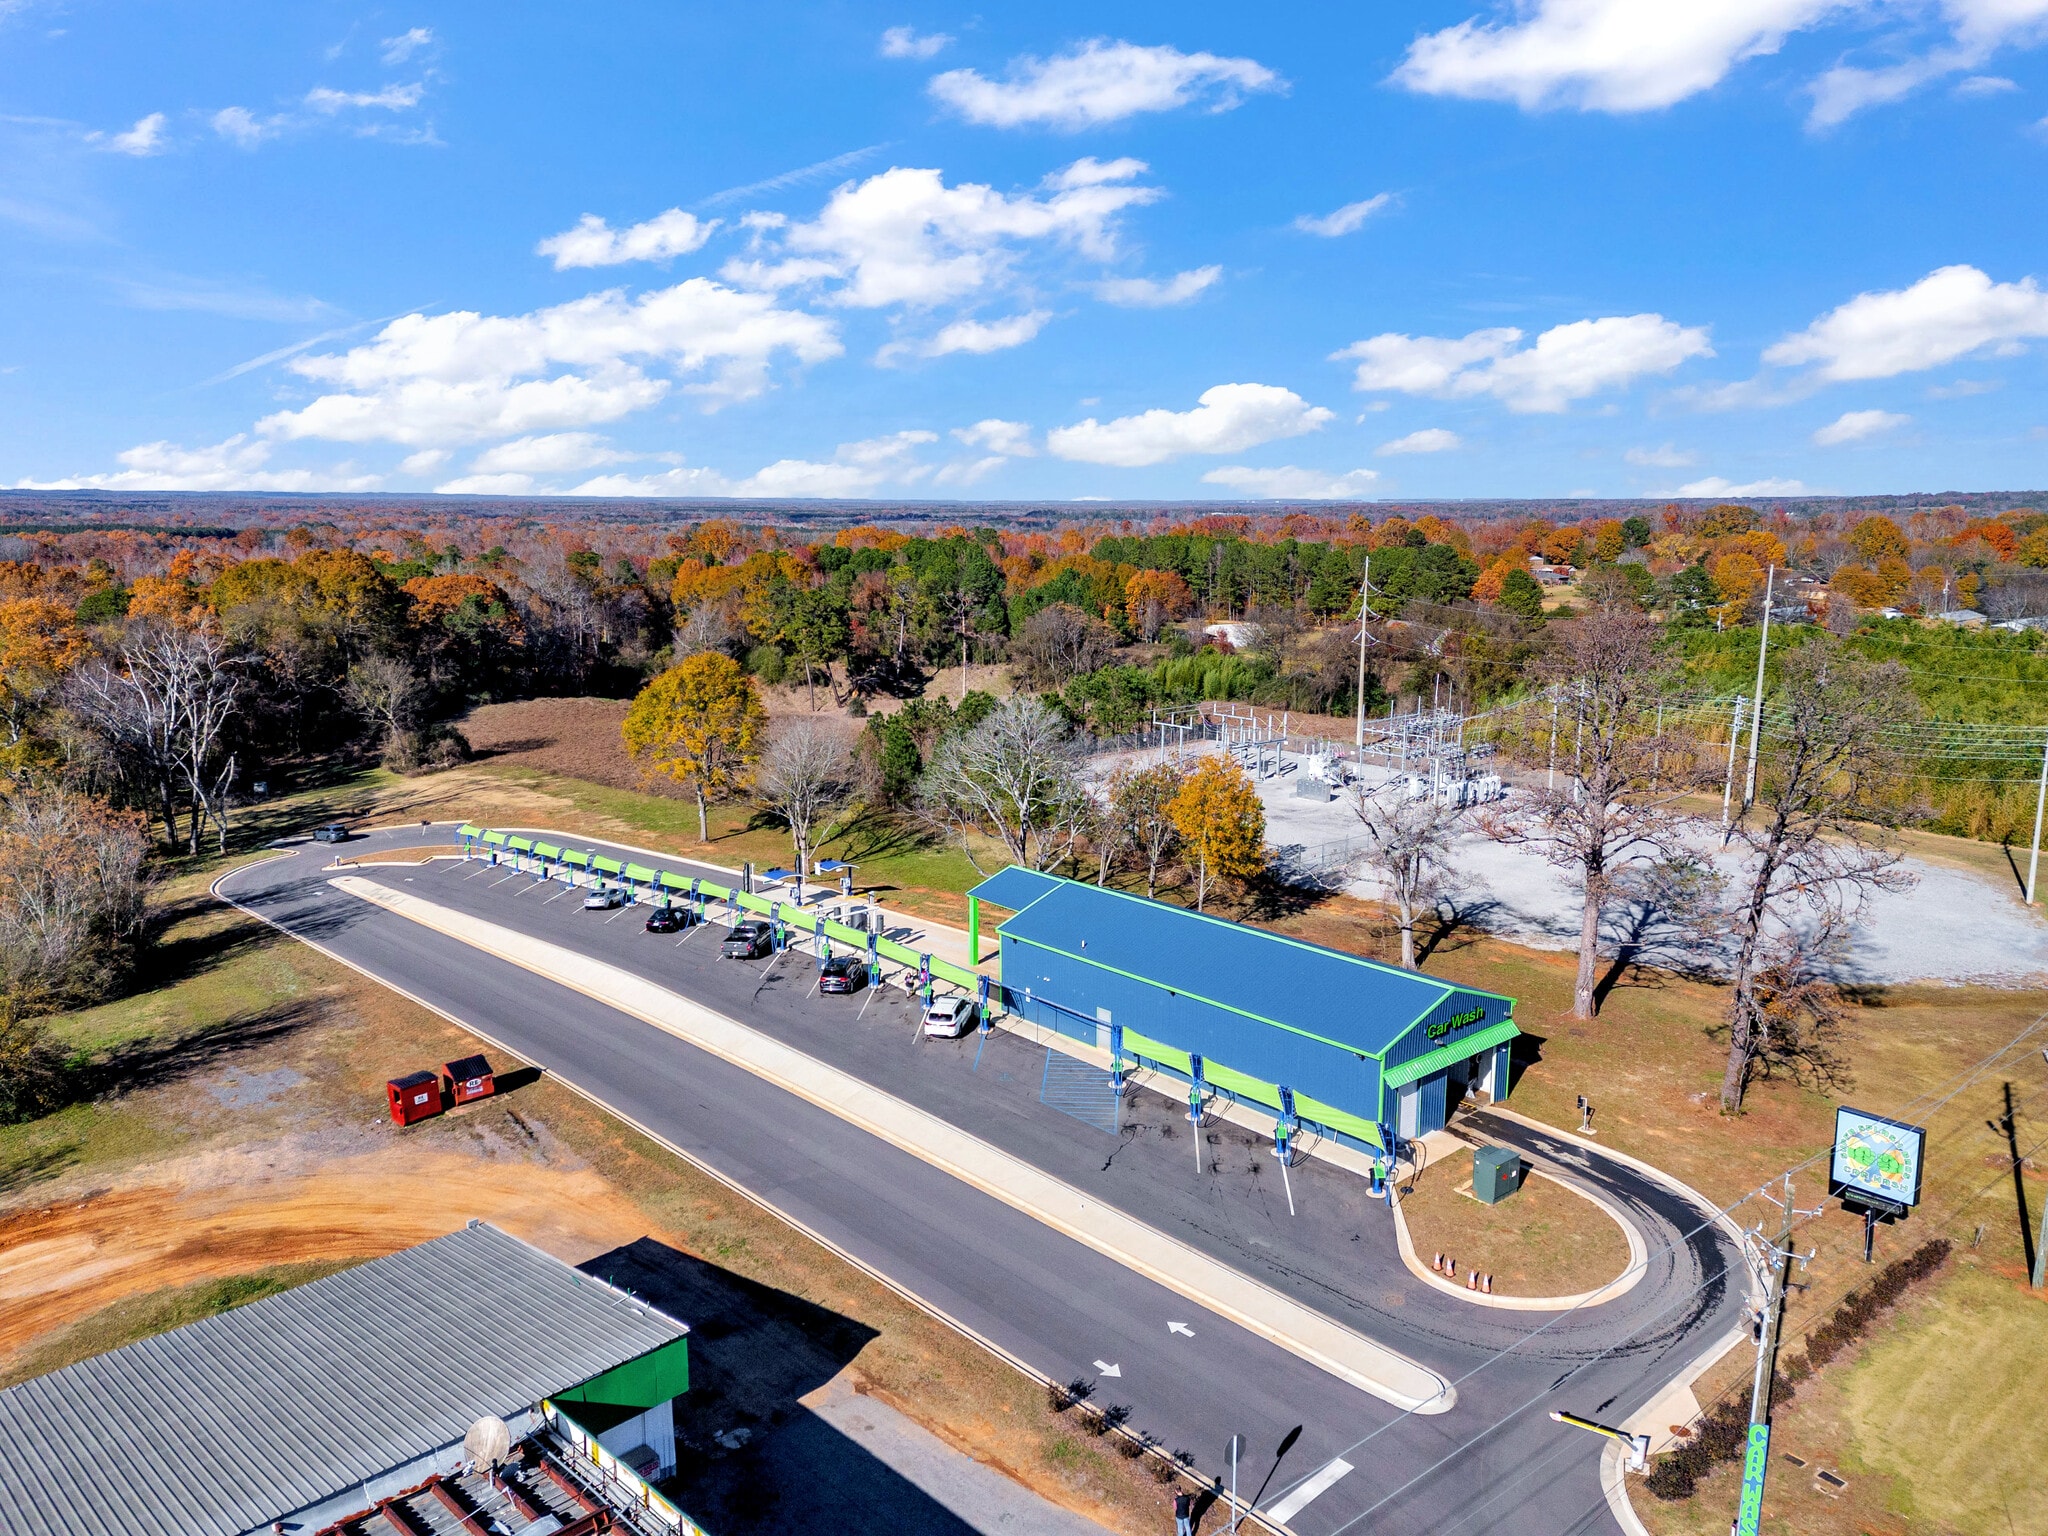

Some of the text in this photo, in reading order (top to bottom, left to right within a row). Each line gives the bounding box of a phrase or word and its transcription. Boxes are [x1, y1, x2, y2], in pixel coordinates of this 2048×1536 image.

[1427, 1006, 1484, 1039] Car Wash
[1843, 1165, 1909, 1192] CAR WASH
[1745, 1424, 1768, 1483] CAR
